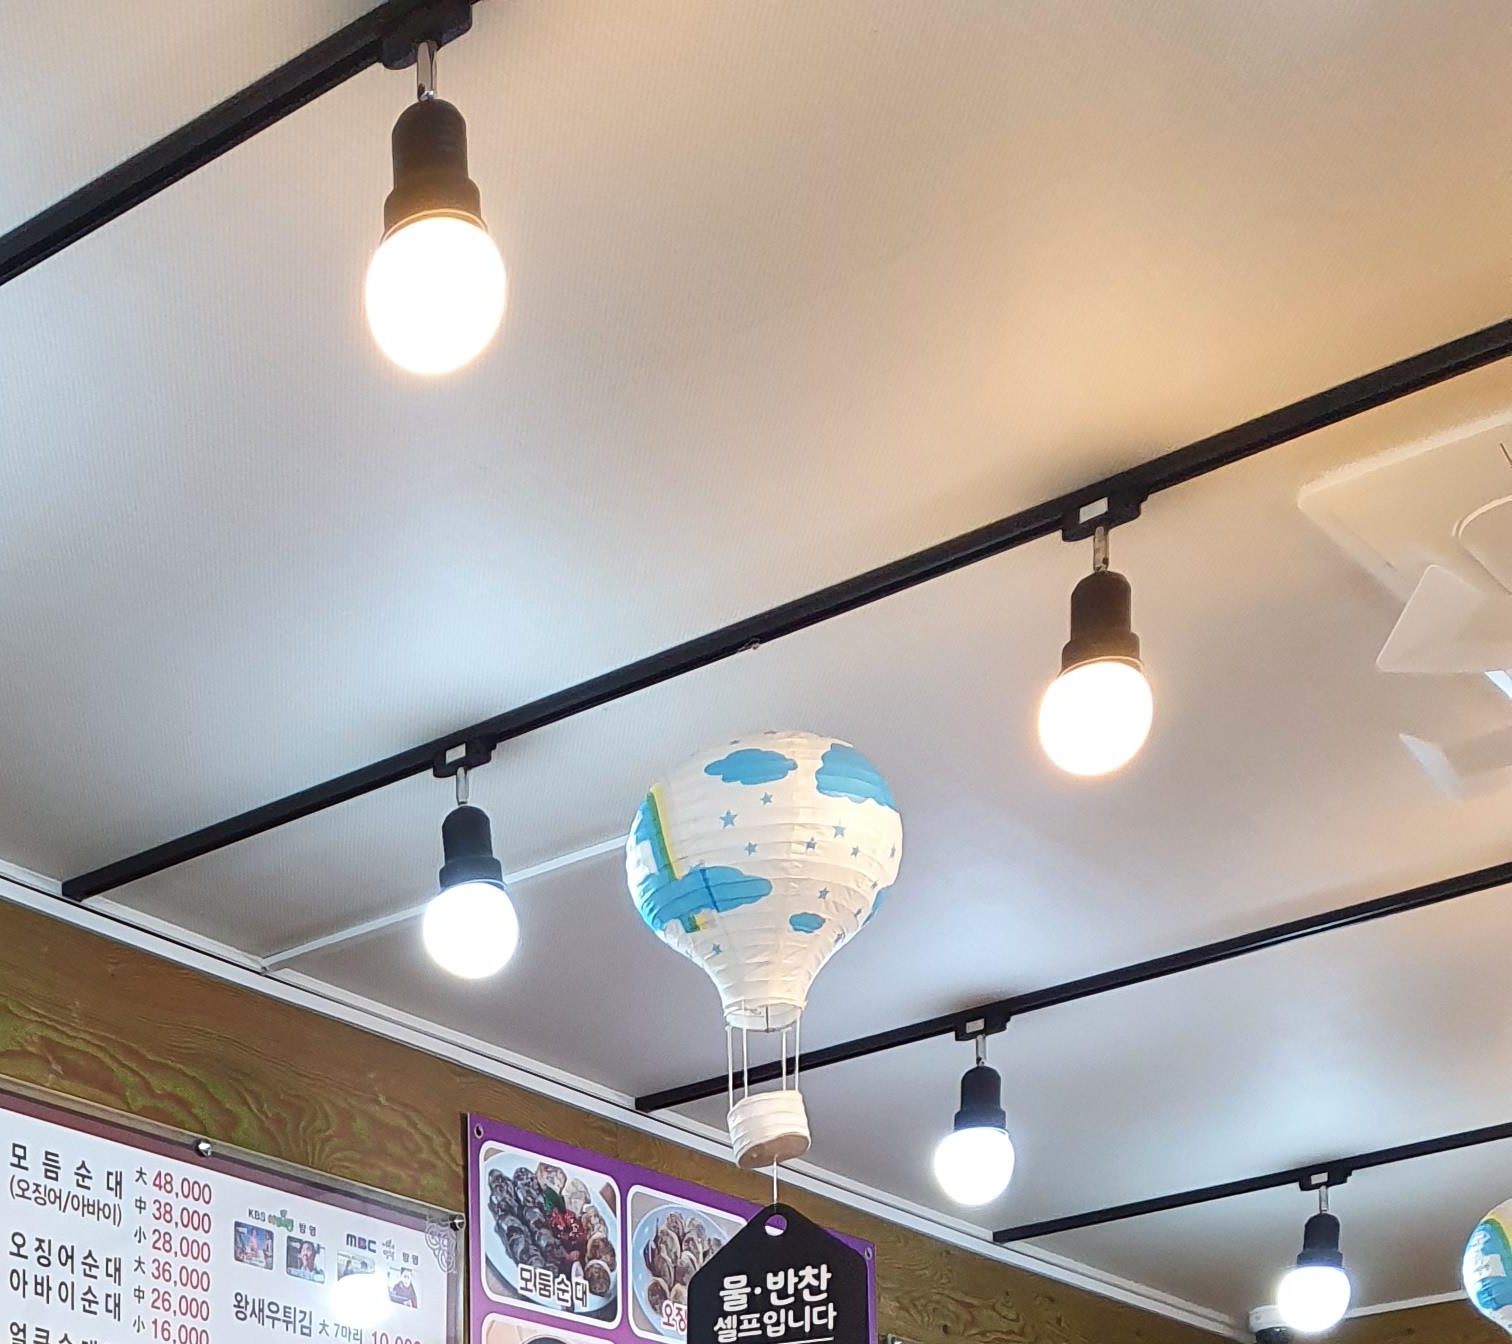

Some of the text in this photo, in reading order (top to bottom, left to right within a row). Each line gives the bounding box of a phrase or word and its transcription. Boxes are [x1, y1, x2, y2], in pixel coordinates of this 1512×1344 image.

[9, 1174, 212, 1234] (오징어/아바이) 38,000
[152, 1170, 212, 1205] 48,000
[151, 1229, 211, 1263] 28,000
[151, 1258, 211, 1292] 36,000
[518, 1265, 589, 1309] 모둠순대
[150, 1288, 210, 1322] 26,000
[233, 1291, 312, 1338] 왕새우튀김
[333, 1324, 363, 1344] 7마리
[713, 1303, 837, 1344] 셀프입니다
